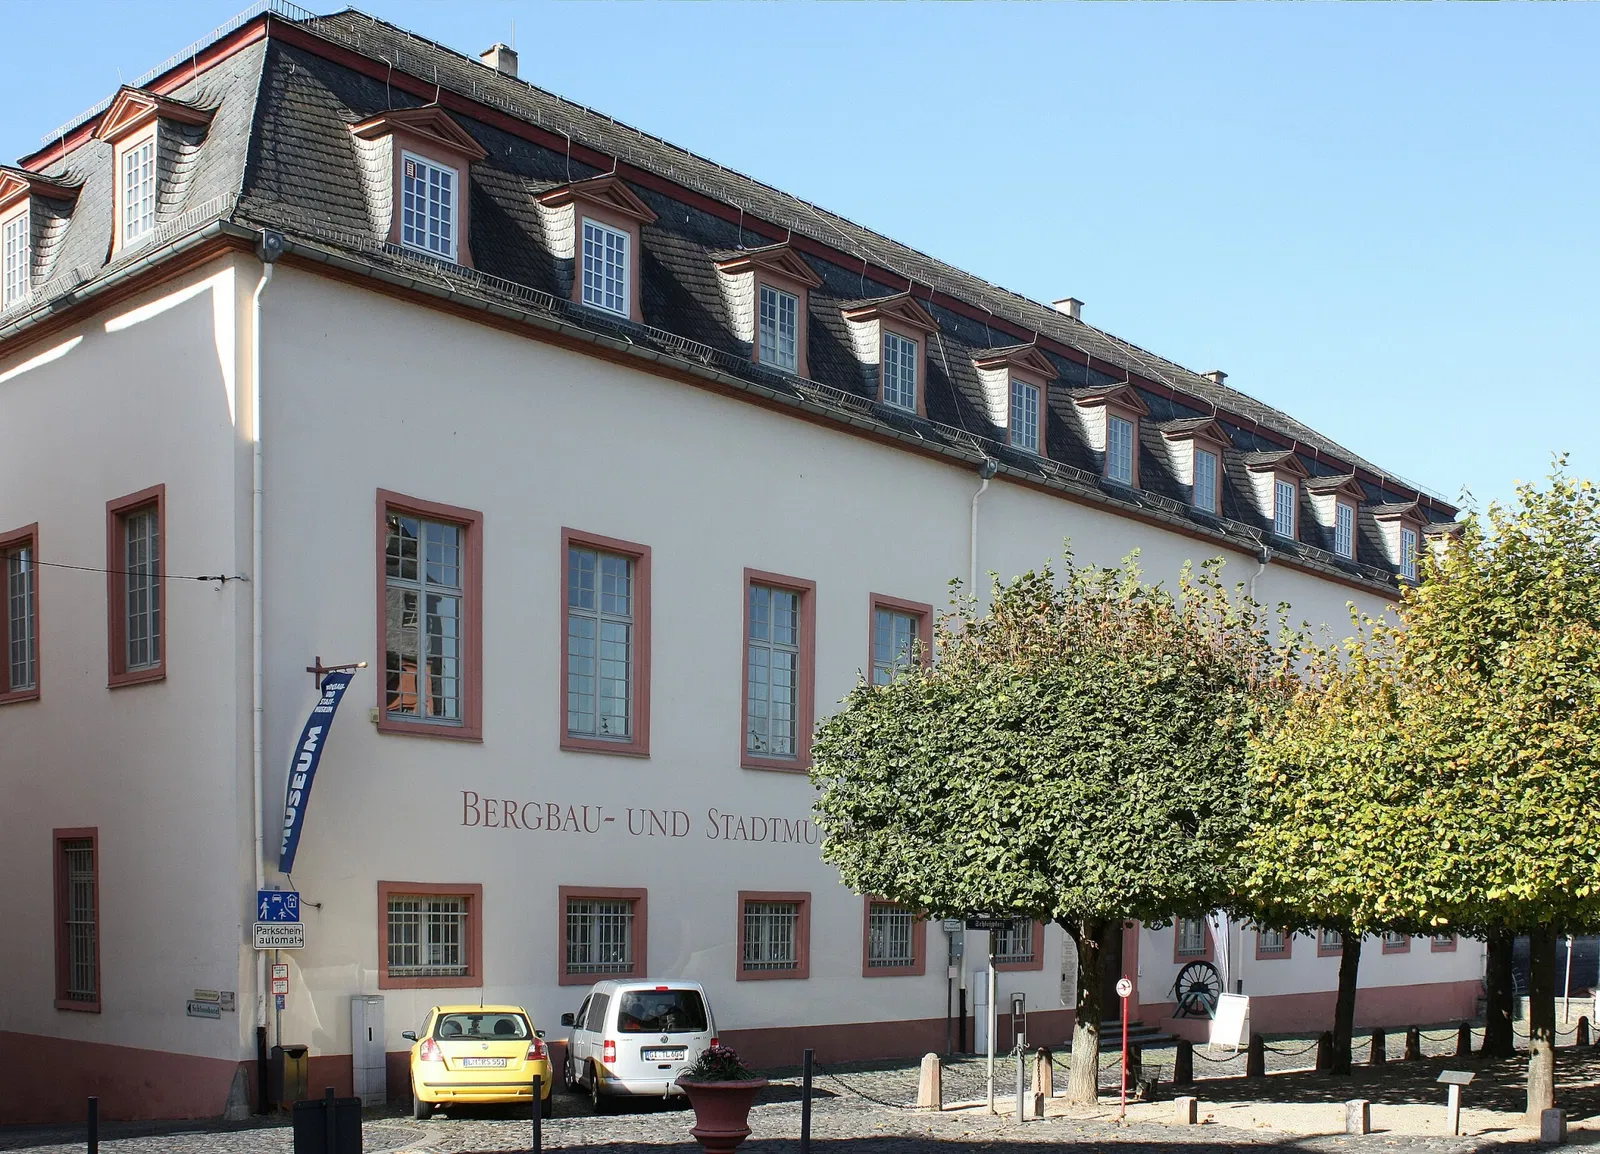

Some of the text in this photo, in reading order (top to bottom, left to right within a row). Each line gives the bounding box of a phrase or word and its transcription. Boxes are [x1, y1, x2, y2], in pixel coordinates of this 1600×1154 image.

[280, 725, 322, 855] MUSEUM
[460, 790, 833, 844] BERGBAU- UND STADTMU
[259, 936, 297, 944] automat
